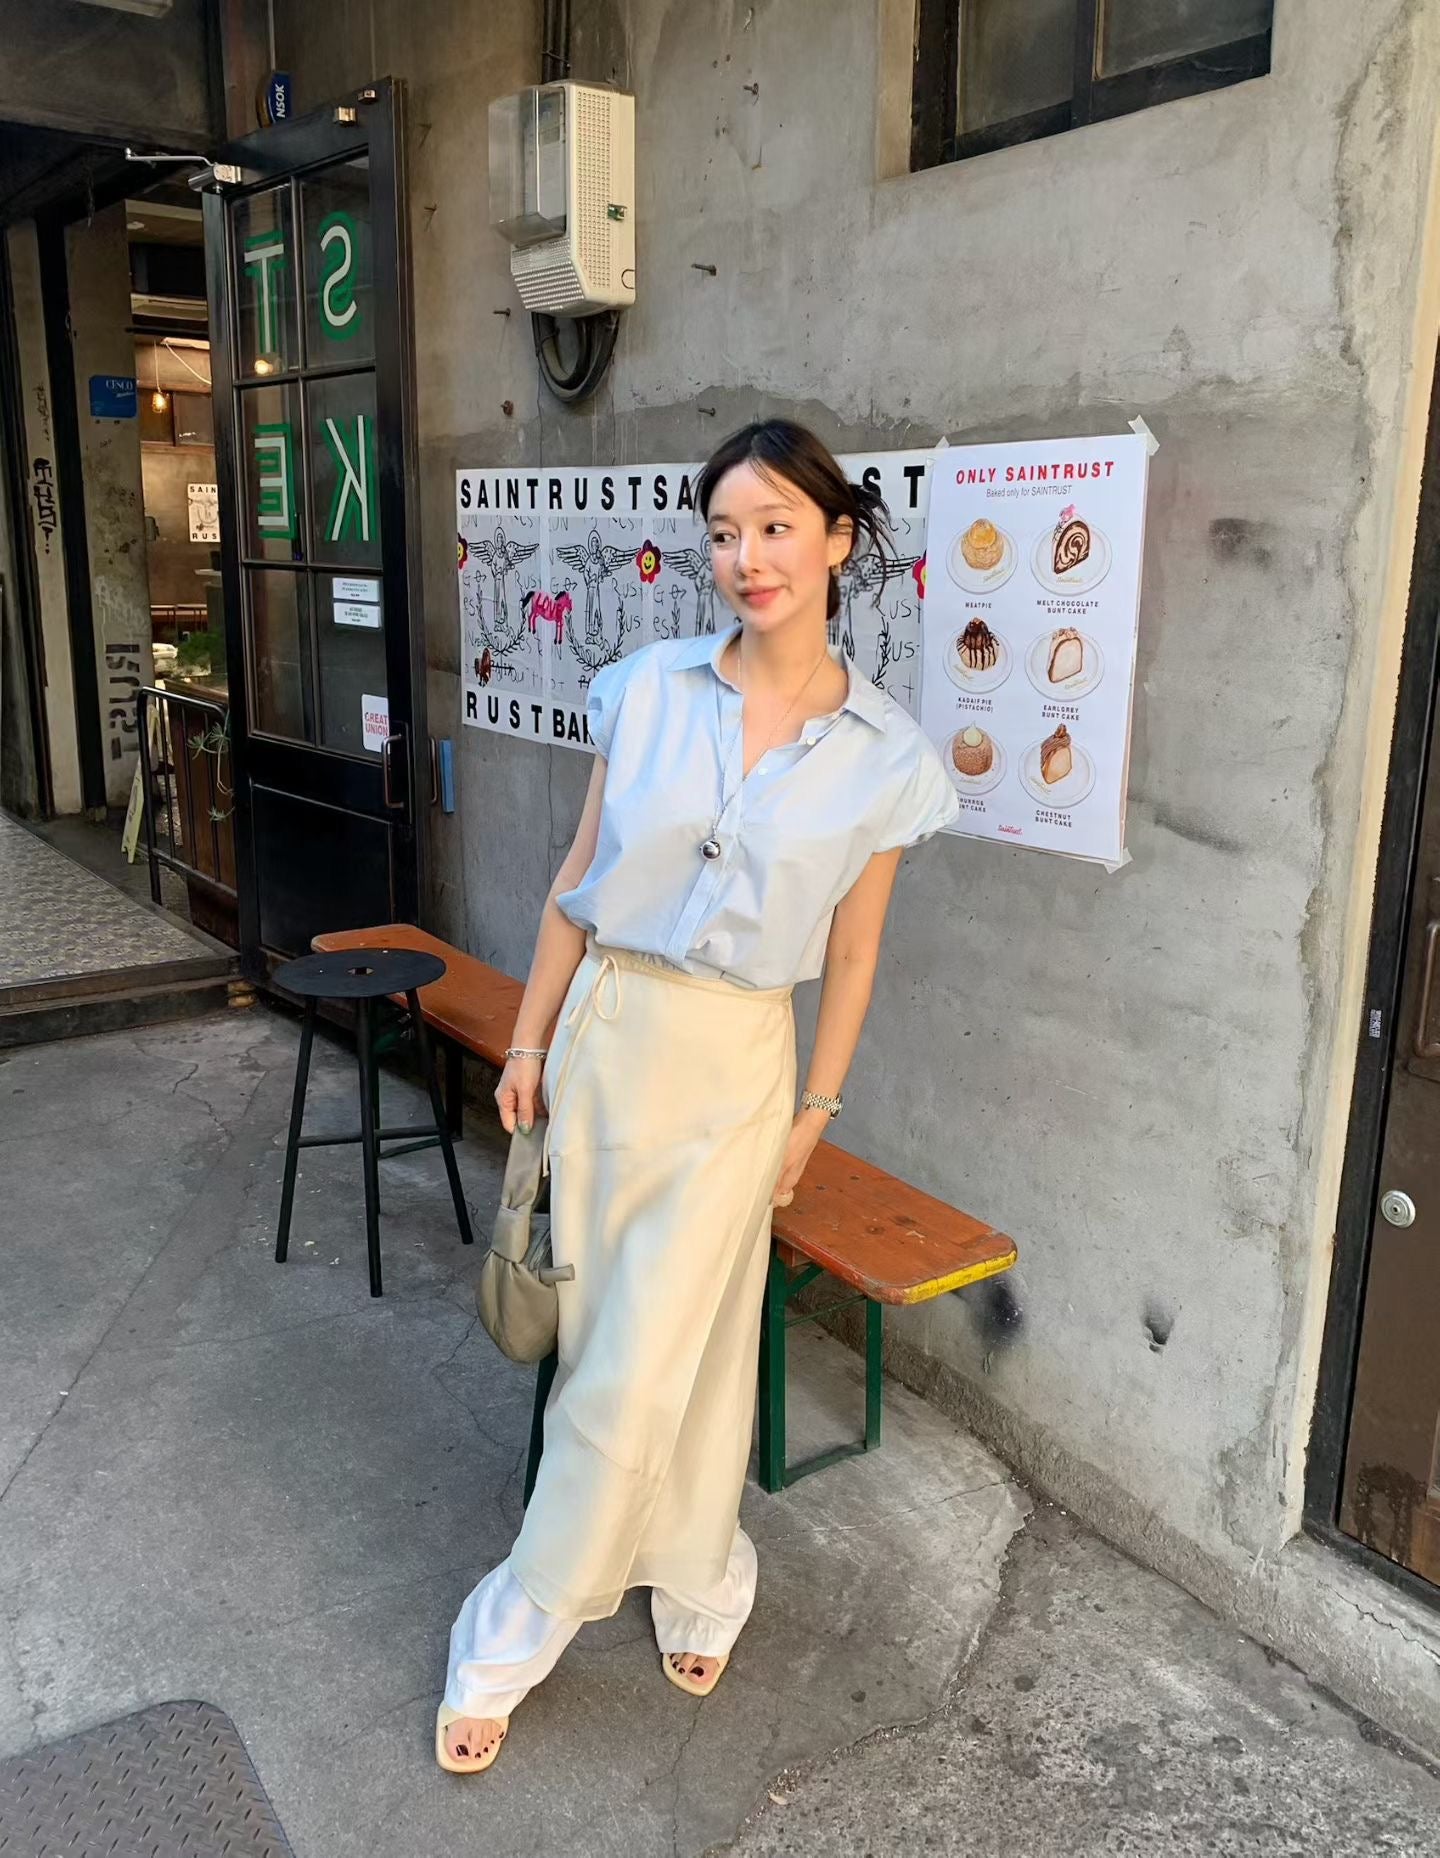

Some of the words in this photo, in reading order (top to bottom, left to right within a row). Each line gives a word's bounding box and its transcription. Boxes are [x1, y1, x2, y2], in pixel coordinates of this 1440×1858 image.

[274, 83, 286, 118] NSOK
[956, 468, 996, 485] ONLY
[1005, 461, 1115, 482] SAINTRUST
[986, 486, 1006, 498] Baked
[1006, 486, 1020, 498] only
[1021, 486, 1030, 496] for
[1031, 485, 1072, 497] SAINTRUST
[956, 704, 994, 713] (PISTACHIO)
[1041, 711, 1060, 719] BUNT
[1061, 713, 1080, 721] CAKE
[958, 797, 984, 807] HURROS
[1036, 809, 1071, 821] CHESTNUT
[1035, 816, 1053, 825] BUNT
[1054, 819, 1073, 828] CAKE
